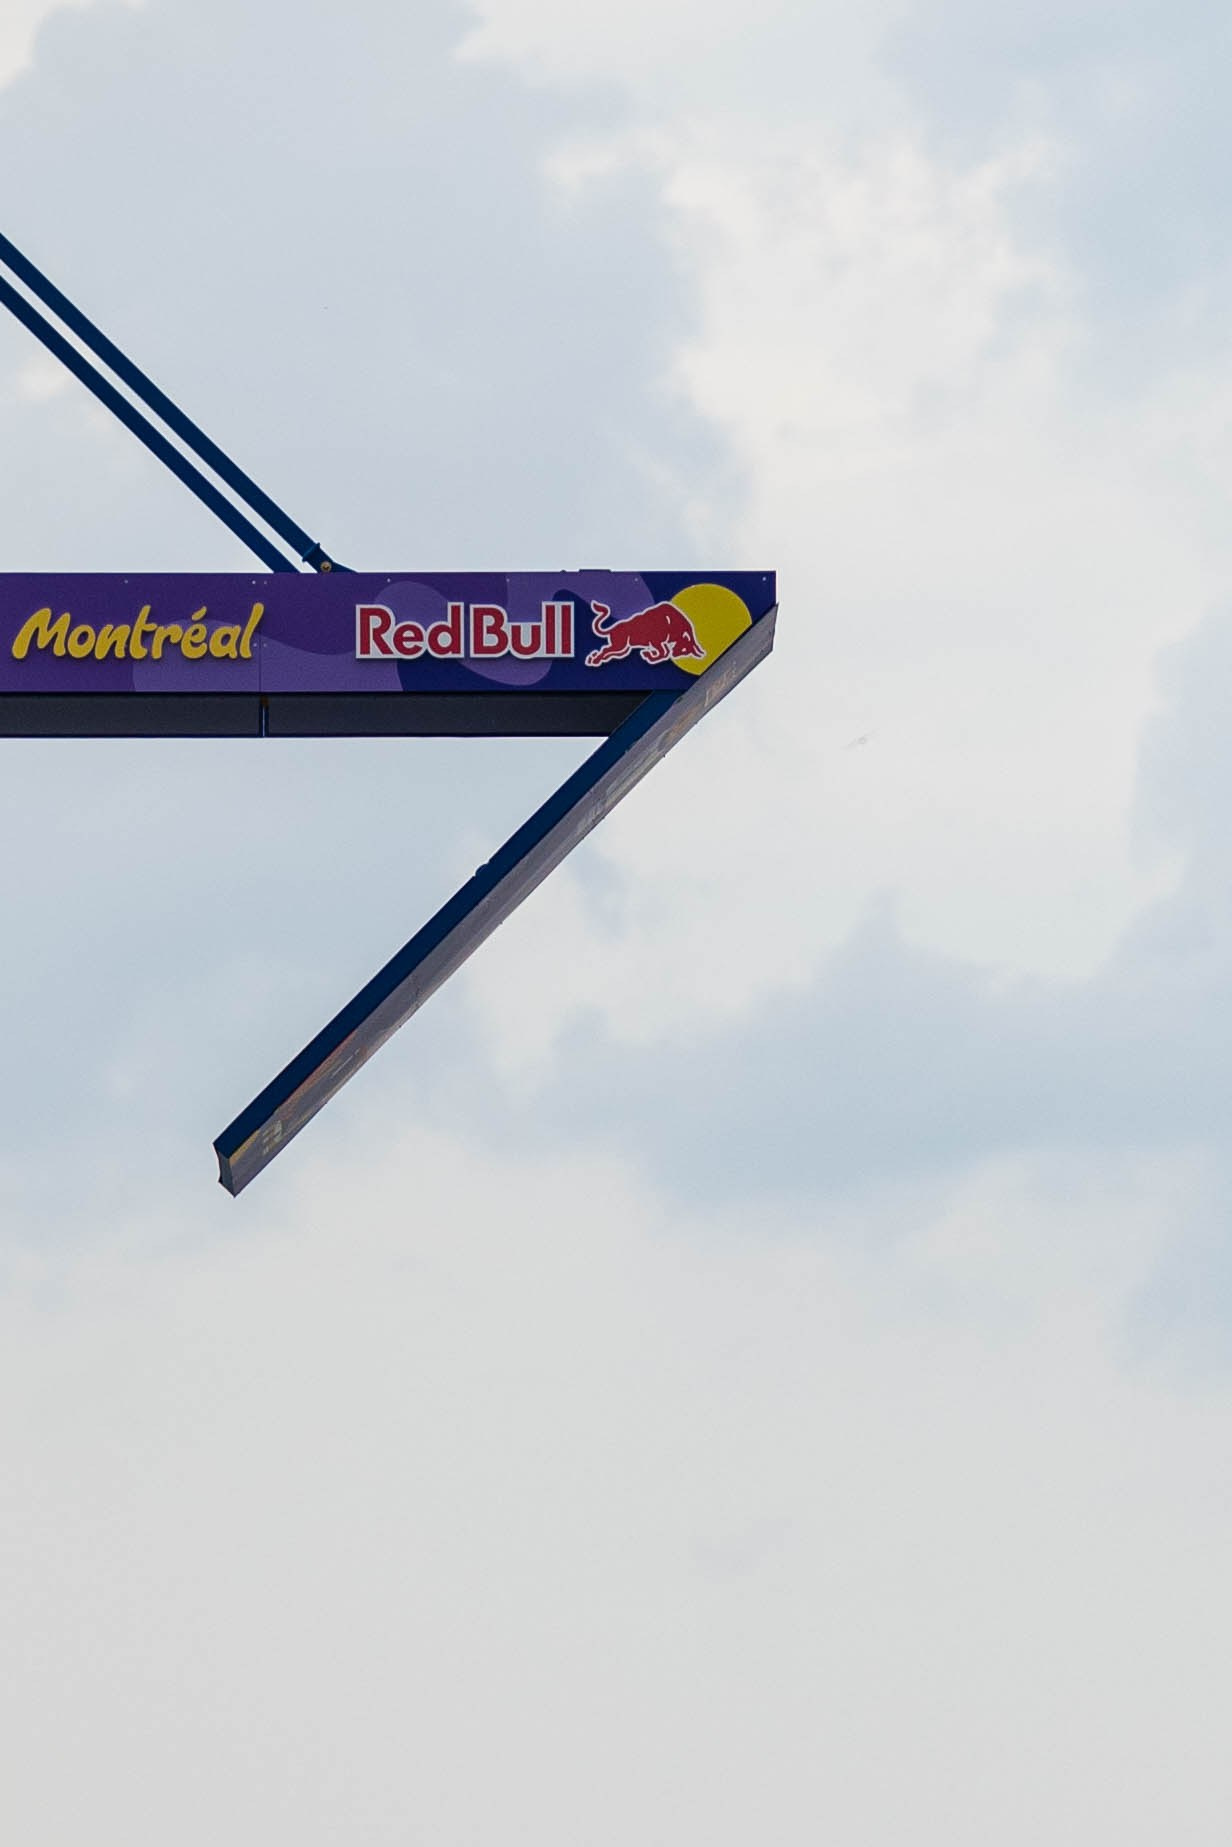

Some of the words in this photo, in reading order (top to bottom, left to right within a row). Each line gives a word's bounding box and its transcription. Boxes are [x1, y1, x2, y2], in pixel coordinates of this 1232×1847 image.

[11, 602, 264, 660] Montréal
[357, 603, 463, 657] Red
[471, 603, 573, 657] Bull
